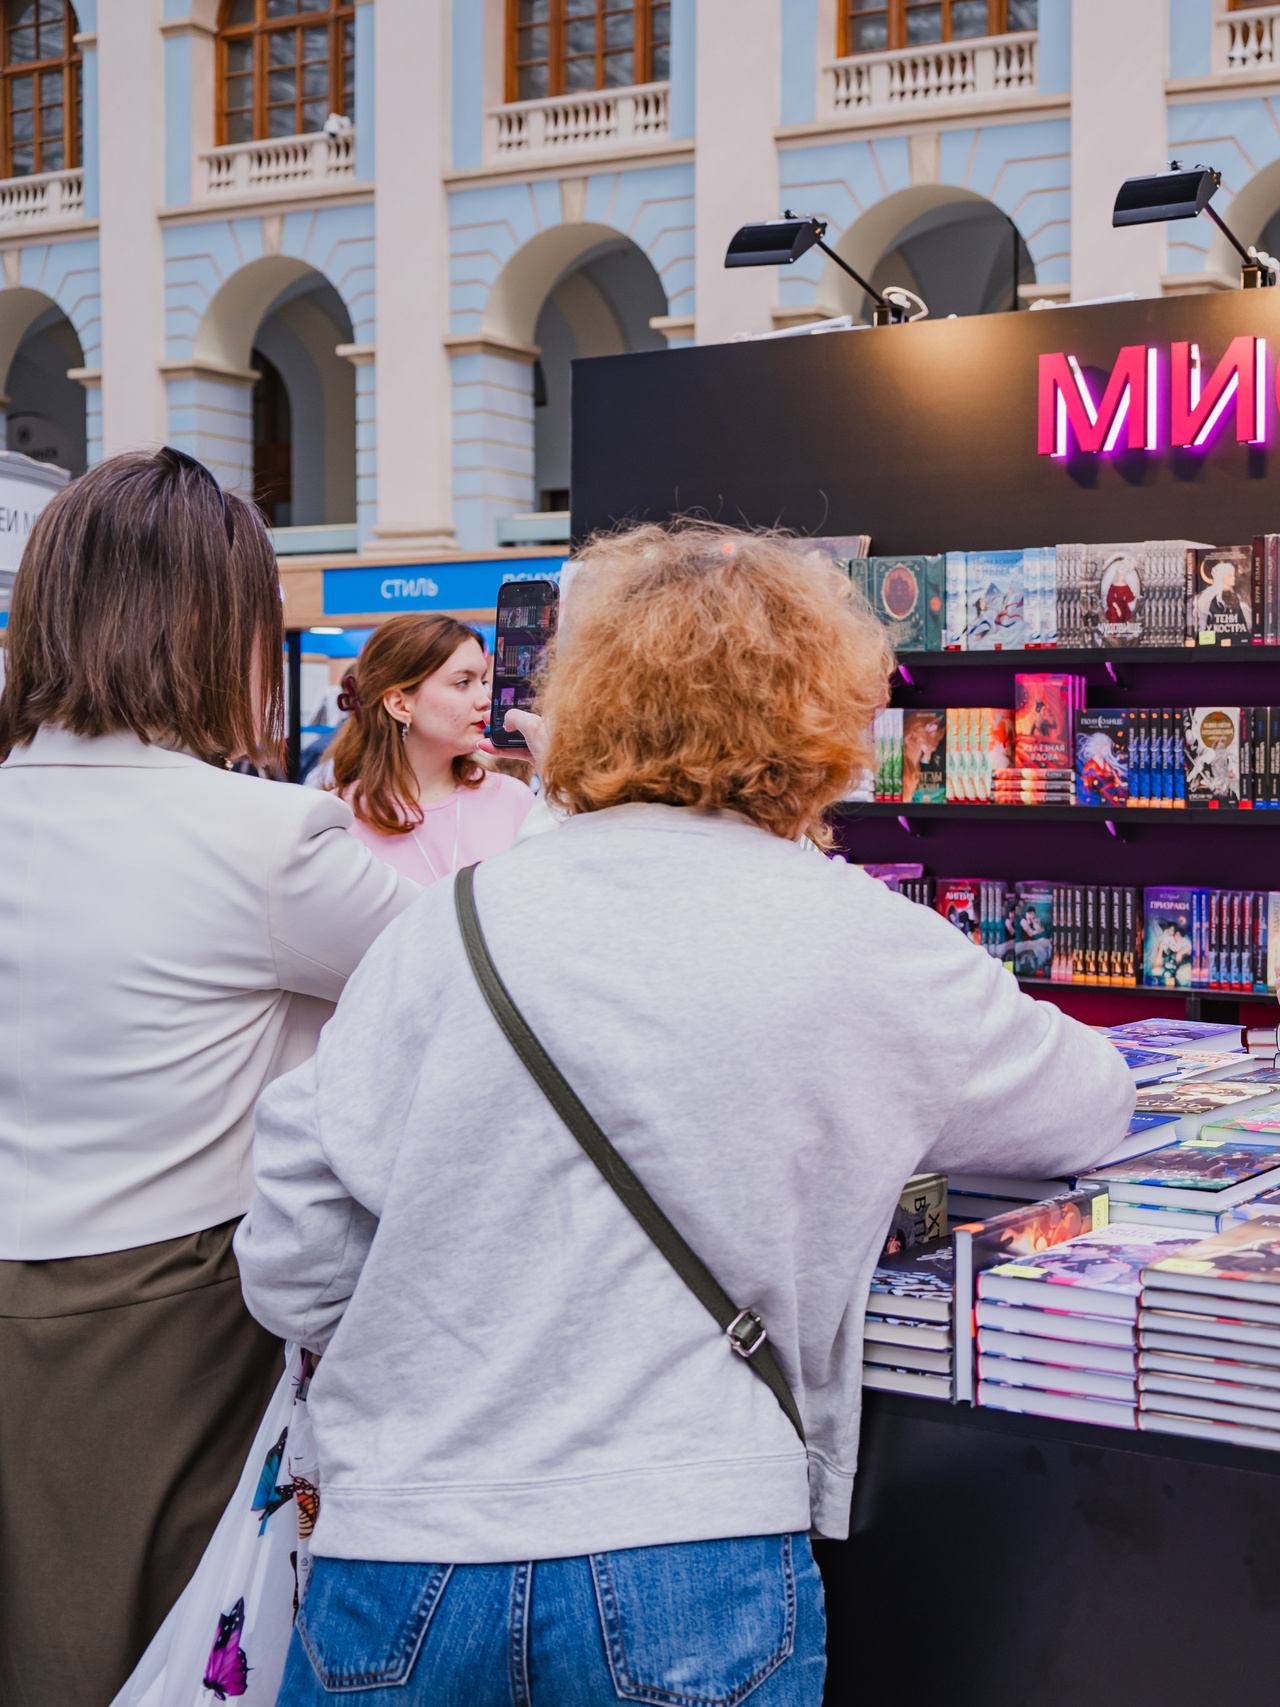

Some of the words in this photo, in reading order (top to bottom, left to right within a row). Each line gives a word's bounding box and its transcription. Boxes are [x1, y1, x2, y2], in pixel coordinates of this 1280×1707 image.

[380, 577, 439, 599] СТИЛЬ
[1213, 613, 1239, 623] ТЕНИ
[1214, 623, 1247, 633] КОСТРА
[1150, 901, 1190, 911] ПРИЗРАКИ
